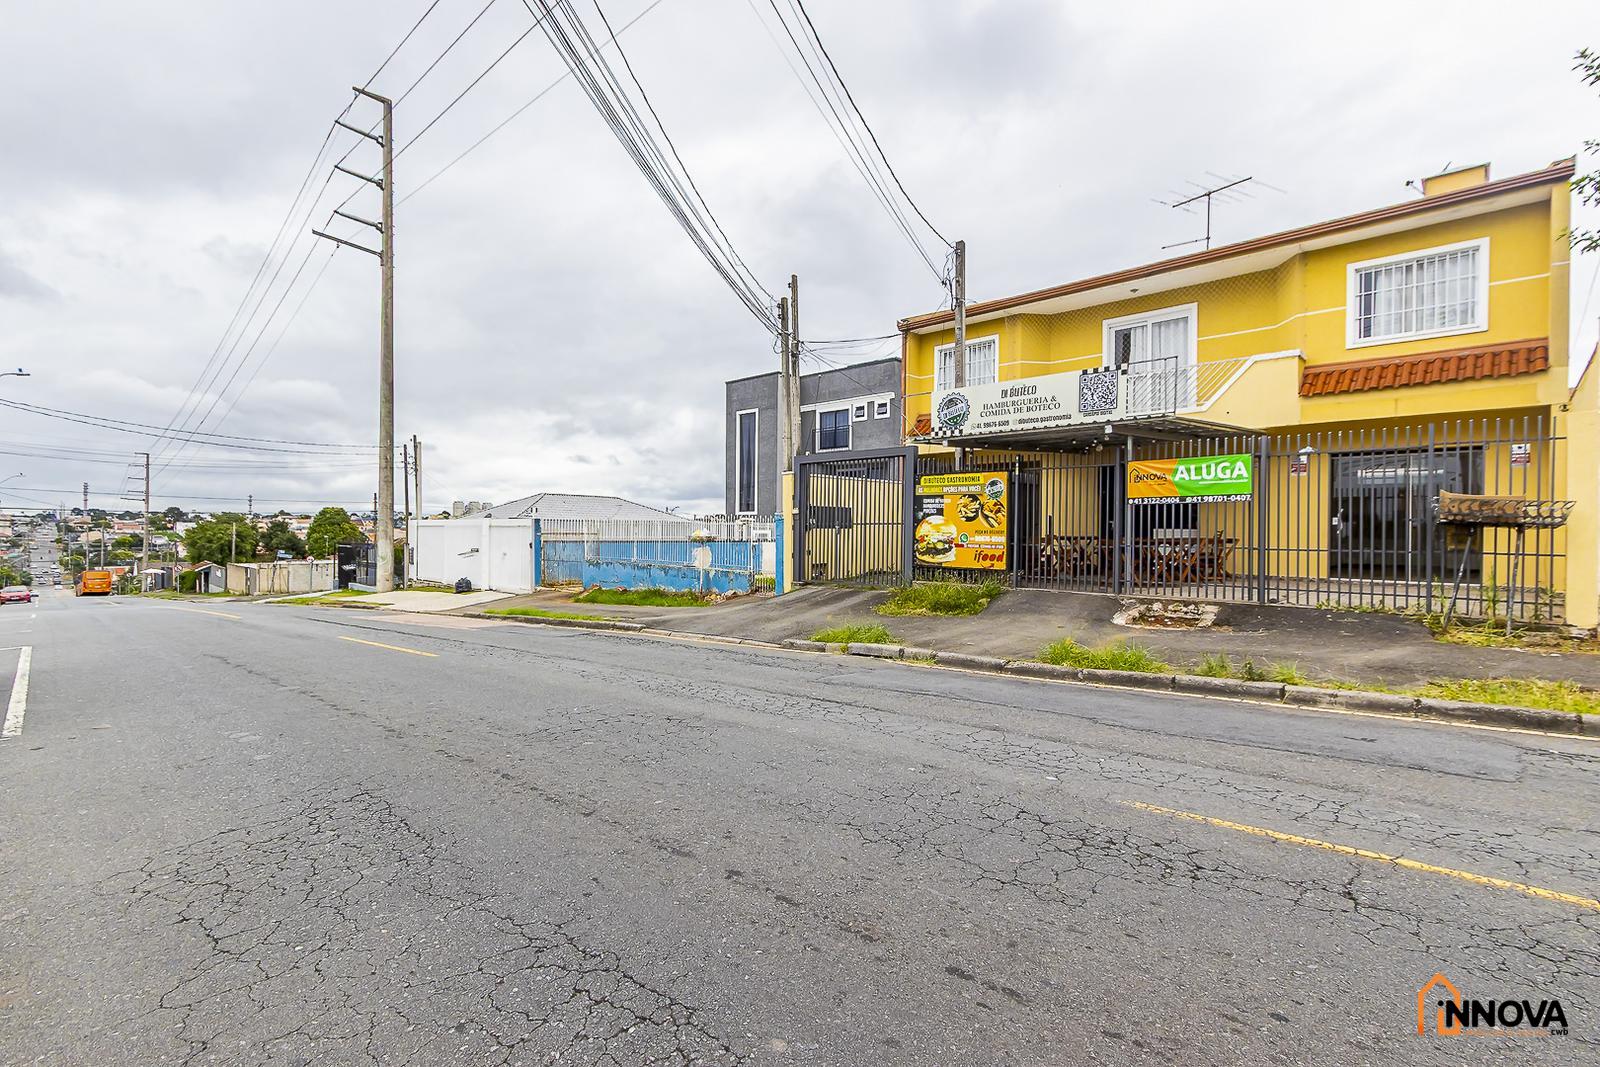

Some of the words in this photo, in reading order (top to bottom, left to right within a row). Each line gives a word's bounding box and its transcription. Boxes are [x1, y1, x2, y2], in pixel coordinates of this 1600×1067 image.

[980, 408, 1012, 418] COMIDA
[1013, 406, 1025, 414] DE
[1026, 402, 1061, 413] BOTECO
[983, 396, 1049, 411] HAMBURGUERIA
[1050, 395, 1057, 403] &
[1174, 461, 1249, 481] ALUGA
[1134, 497, 1142, 505] 41
[974, 550, 1005, 564] ifood
